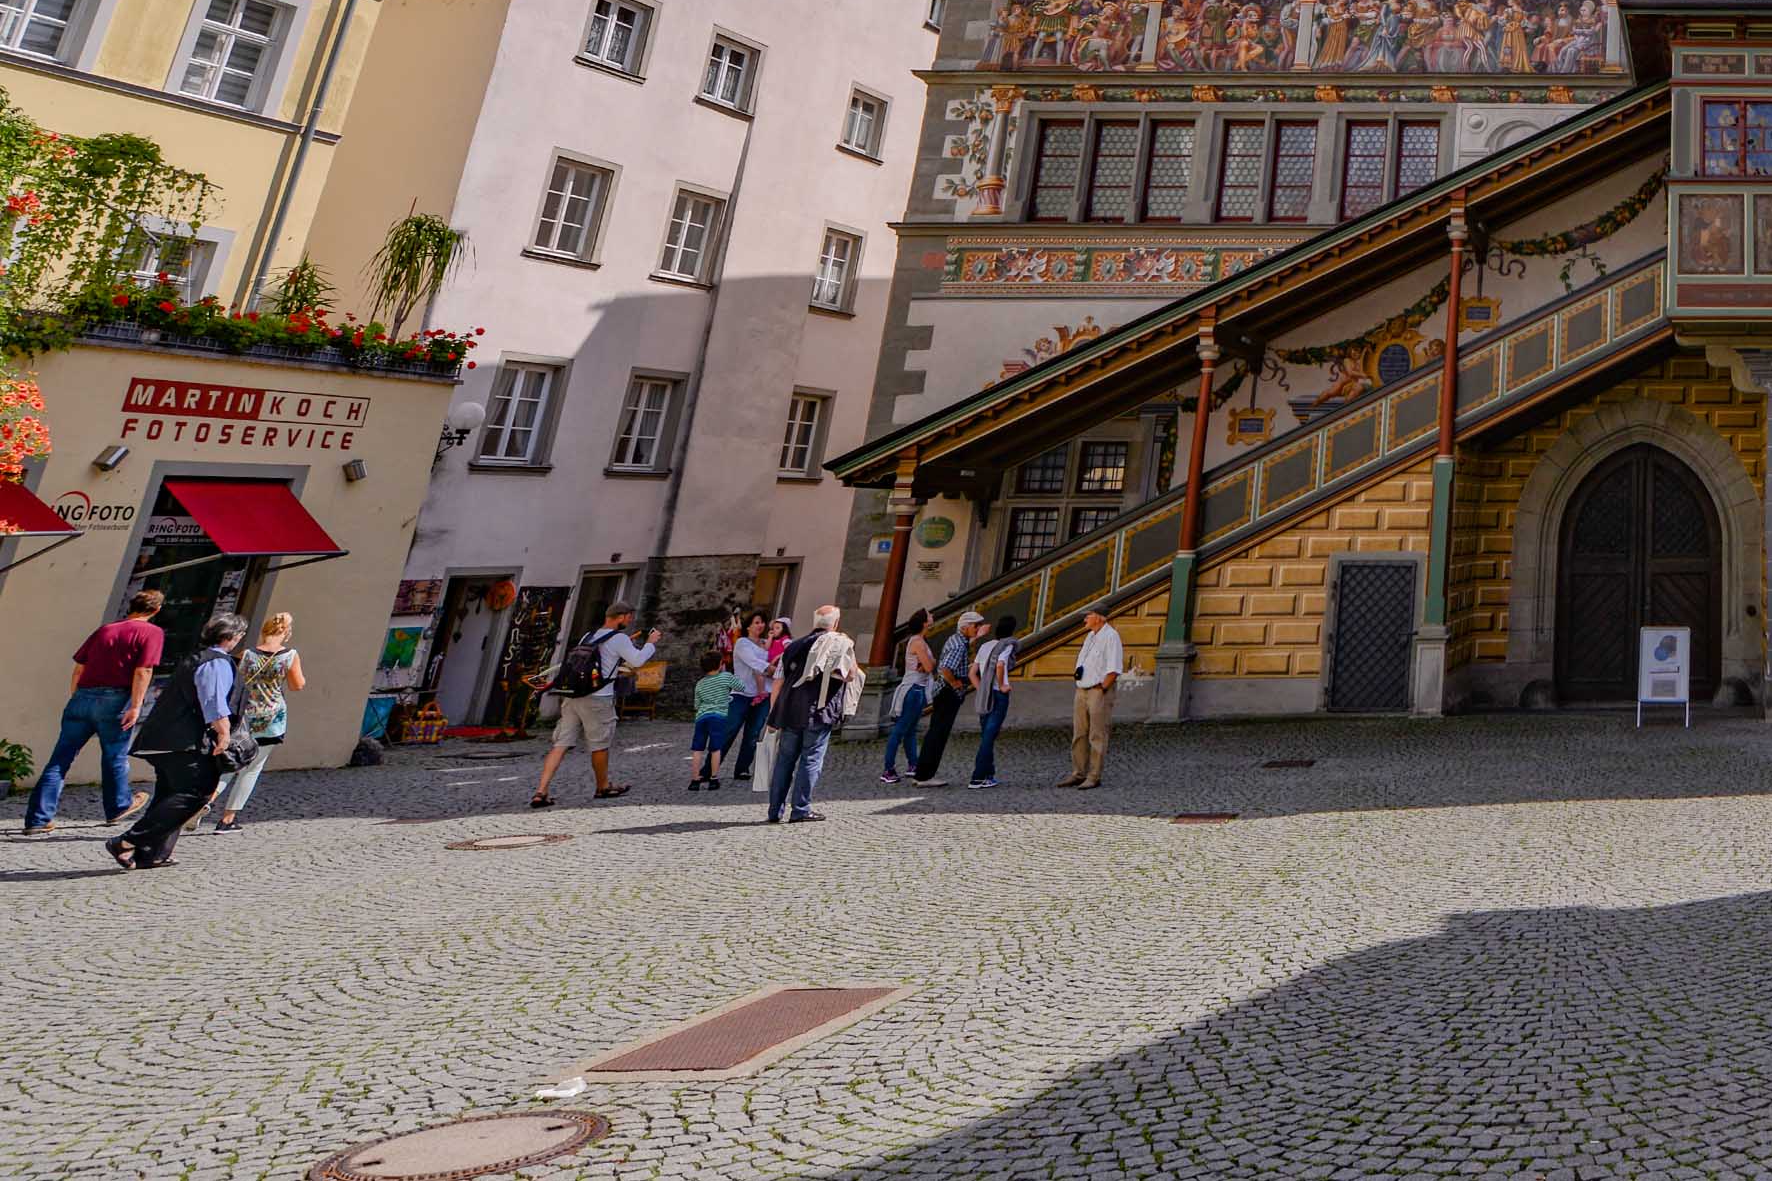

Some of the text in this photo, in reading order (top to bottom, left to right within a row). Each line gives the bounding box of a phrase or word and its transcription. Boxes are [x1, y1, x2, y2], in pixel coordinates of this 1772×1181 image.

[130, 384, 363, 421] MARTIN KOCH
[121, 418, 354, 450] FOTOSERVICE
[51, 505, 135, 521] NG FOTO
[175, 524, 201, 534] FOTO
